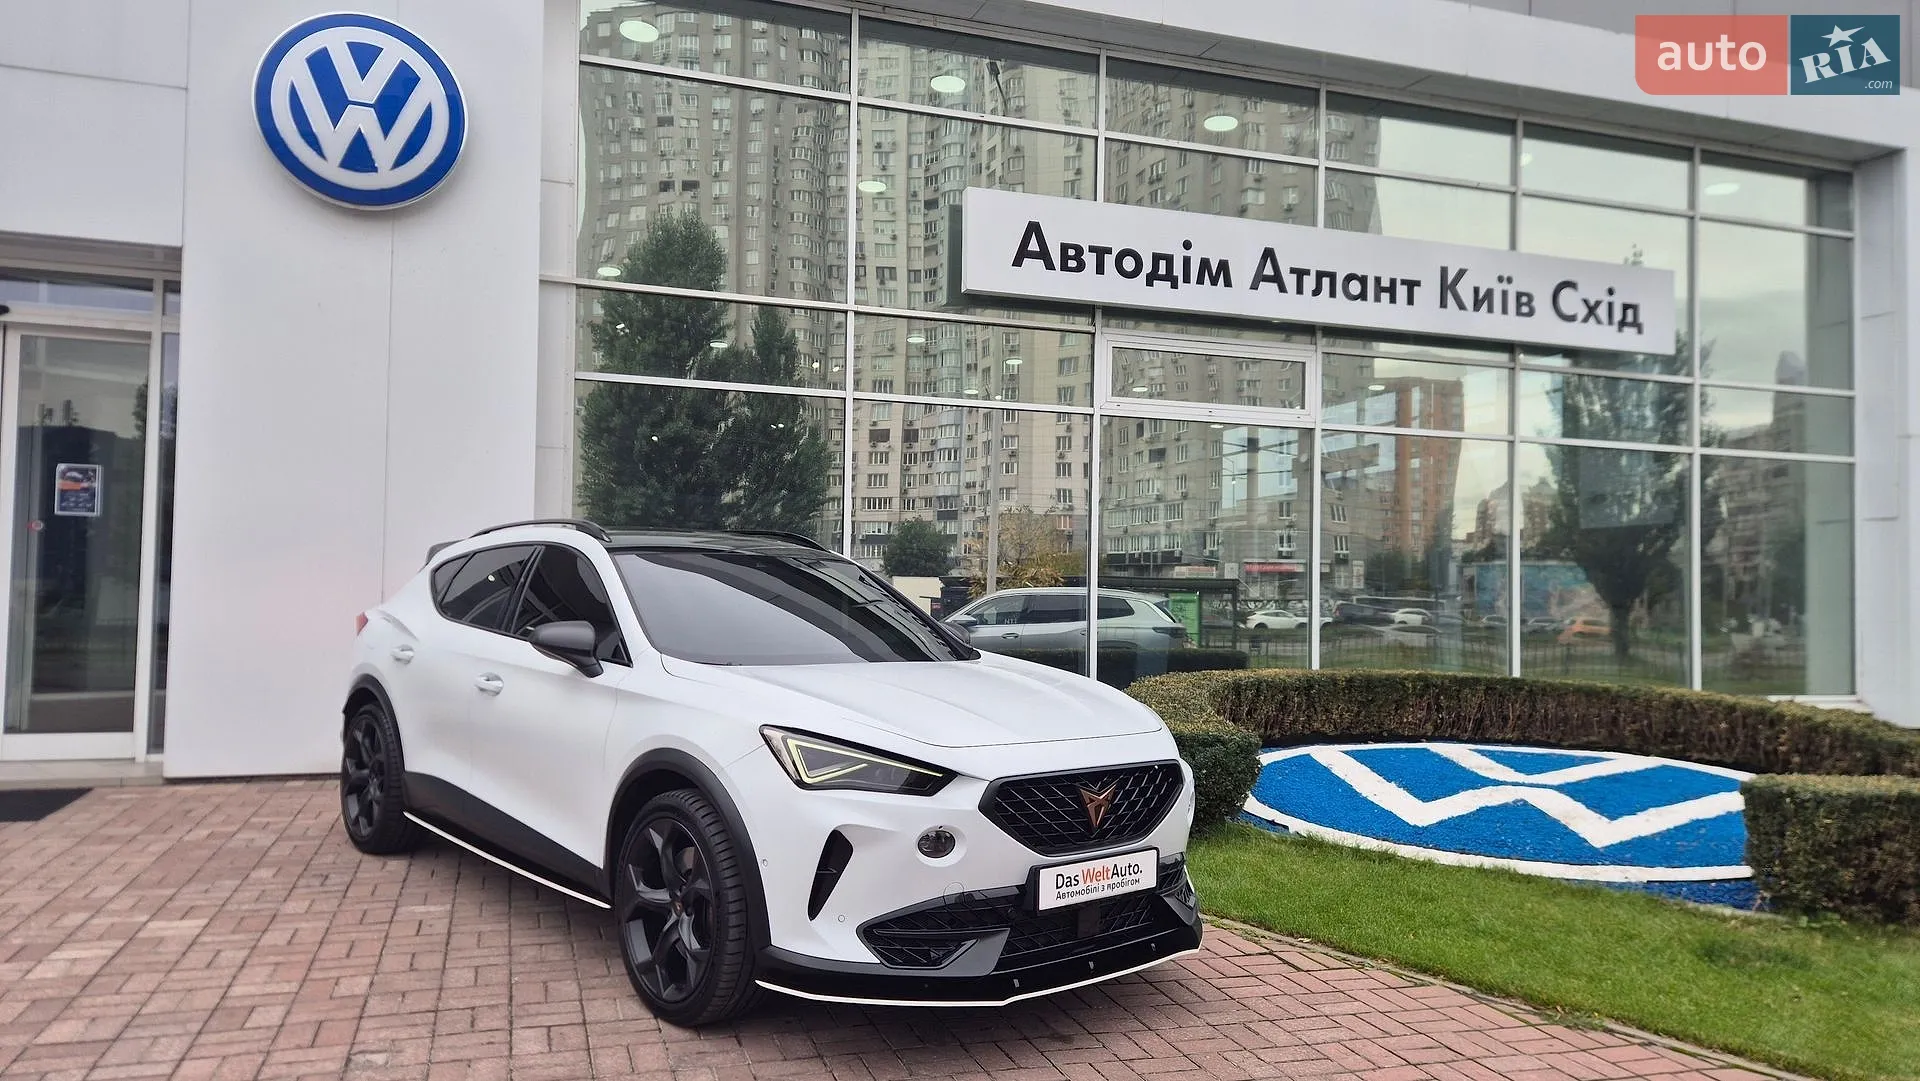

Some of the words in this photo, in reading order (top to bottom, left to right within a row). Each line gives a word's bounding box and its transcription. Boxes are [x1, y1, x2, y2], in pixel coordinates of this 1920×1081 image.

[1011, 220, 1234, 290] Автодім
[1249, 246, 1422, 307] Атлант
[1439, 265, 1536, 319] Київ
[1551, 280, 1644, 336] Схід
[1055, 873, 1080, 890] Das
[1055, 883, 1100, 900] Автомобілі
[1106, 878, 1140, 892] пробігом
